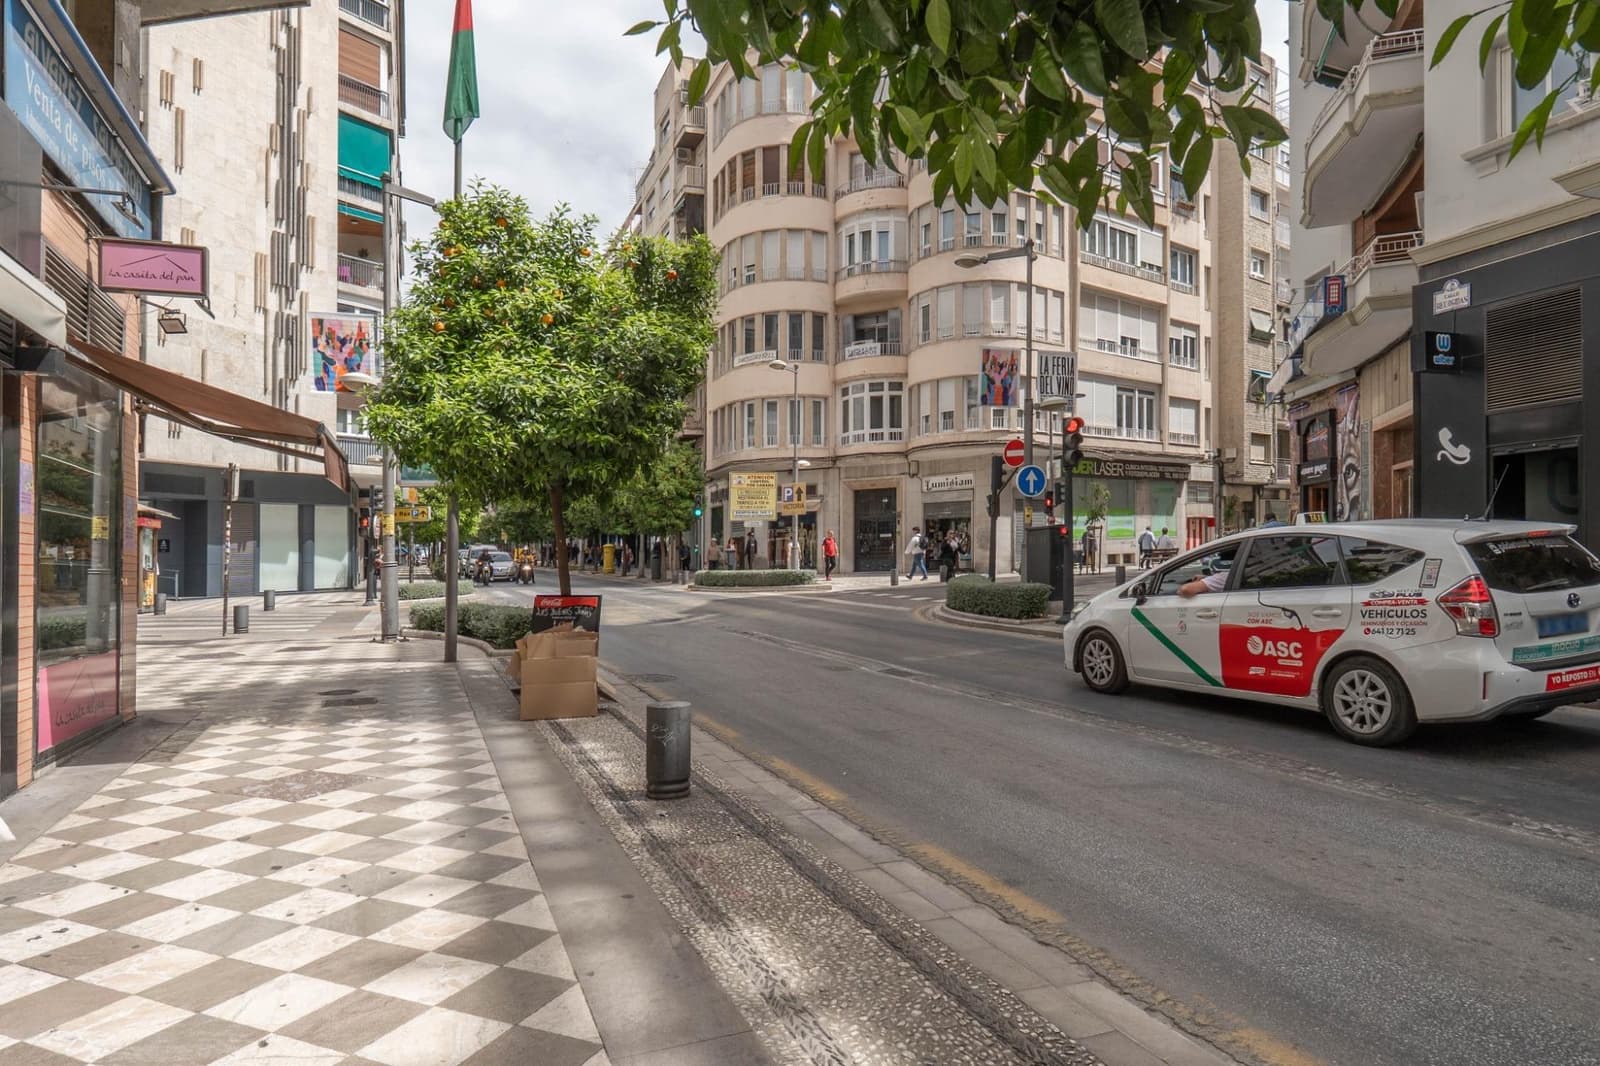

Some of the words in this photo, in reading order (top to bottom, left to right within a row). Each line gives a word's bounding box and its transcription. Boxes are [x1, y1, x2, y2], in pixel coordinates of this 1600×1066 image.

[24, 60, 62, 133] Venta
[65, 120, 78, 151] de
[108, 269, 120, 278] La
[124, 270, 156, 279] casita
[160, 271, 174, 280] del
[1040, 356, 1049, 374] LA
[1052, 356, 1074, 376] FERIA
[1040, 376, 1053, 394] DEL
[1056, 376, 1074, 396] VINO
[1094, 462, 1124, 476] LASER
[785, 488, 792, 501] P
[1264, 640, 1302, 658] ASC
[1552, 676, 1562, 684] YO
[1562, 672, 1588, 682] REPOSTO
